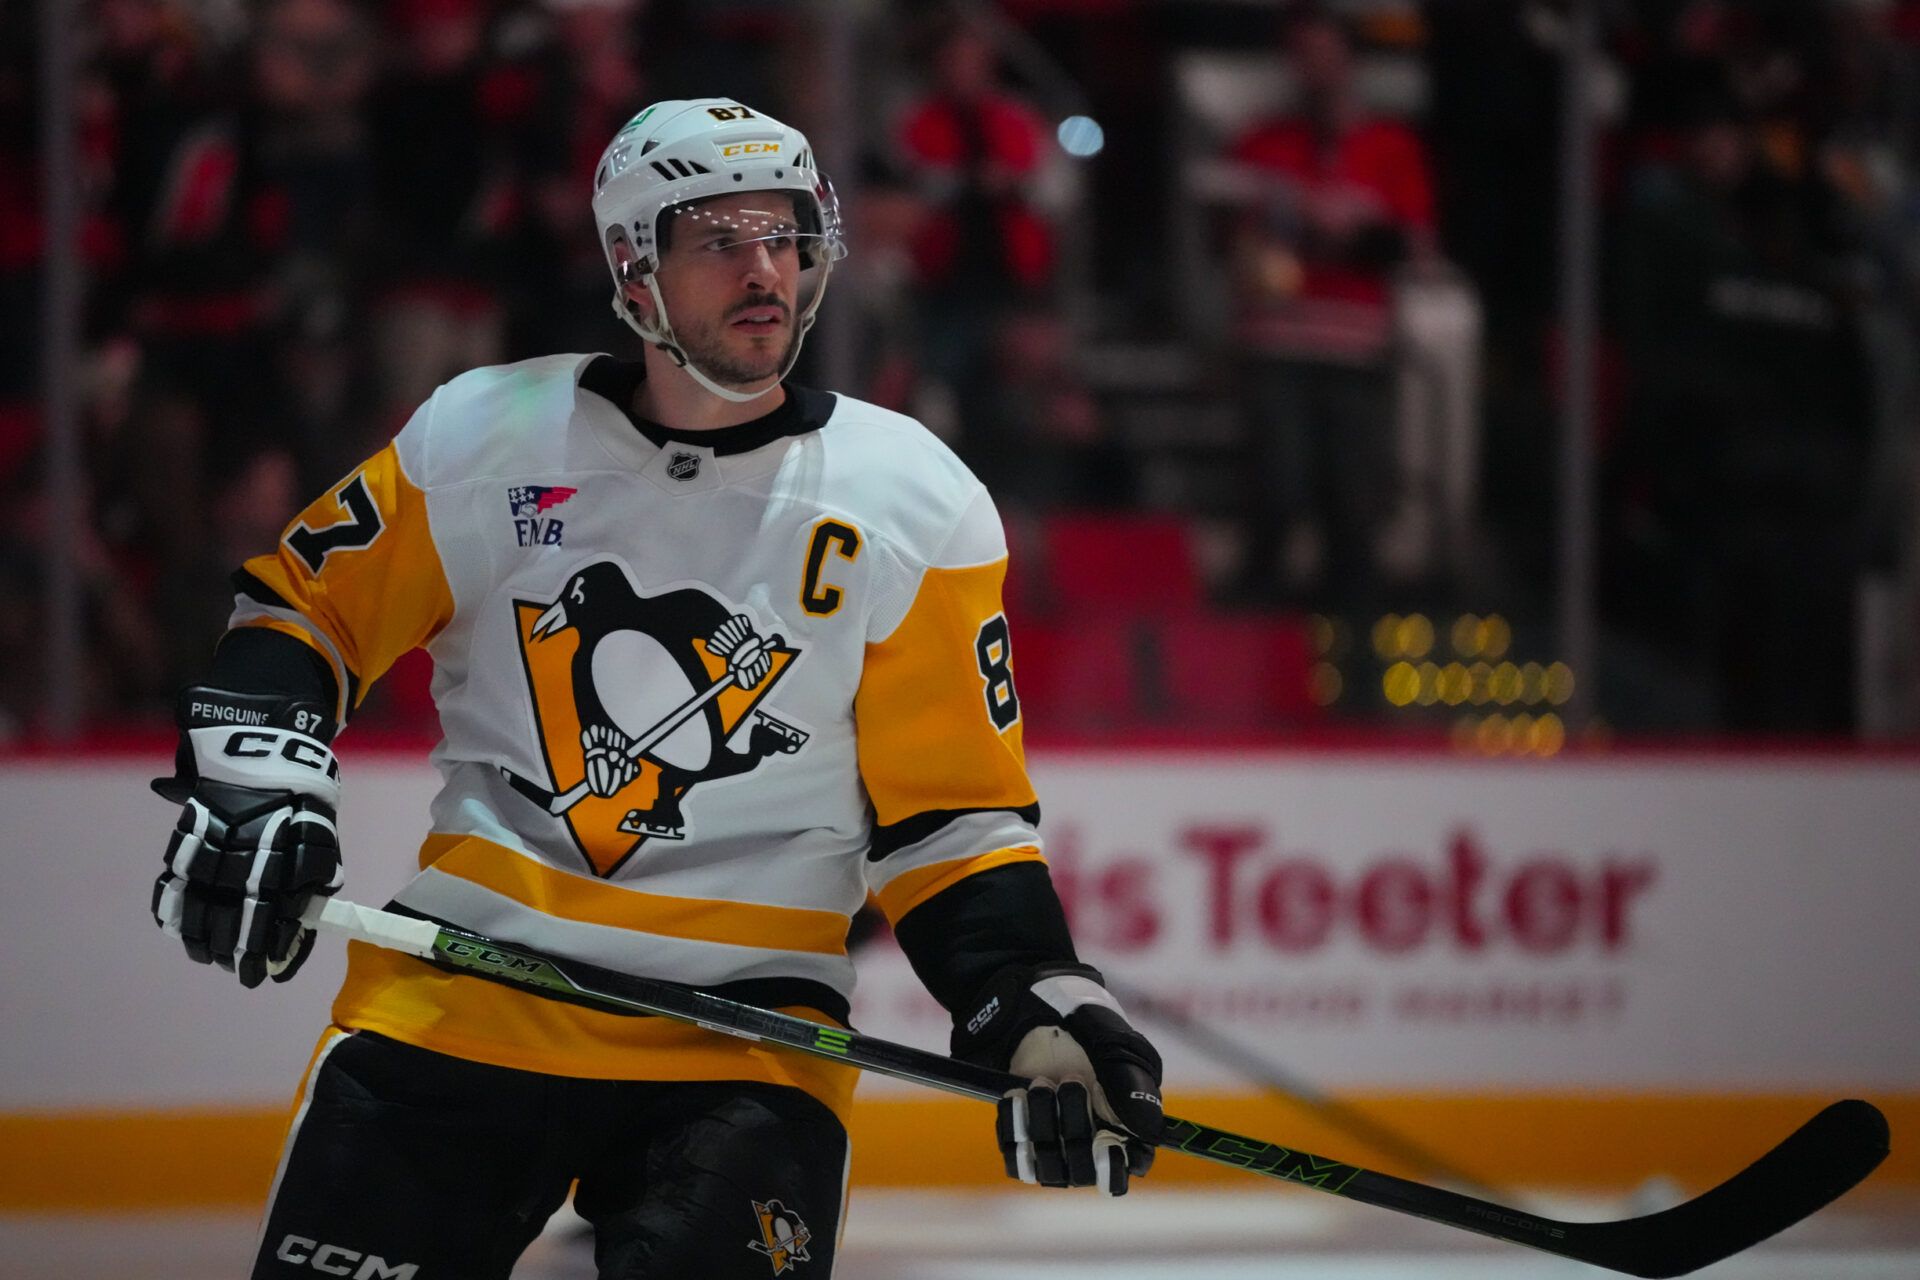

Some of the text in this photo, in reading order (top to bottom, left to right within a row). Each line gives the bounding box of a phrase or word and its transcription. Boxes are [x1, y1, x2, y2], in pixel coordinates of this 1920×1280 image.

[707, 106, 756, 122] 87
[722, 142, 780, 157] CCM
[799, 517, 863, 618] C
[191, 702, 323, 734] PENGUINS 87
[446, 940, 541, 974] CCM
[967, 996, 1000, 1031] CCM
[276, 1234, 420, 1280] CCM
